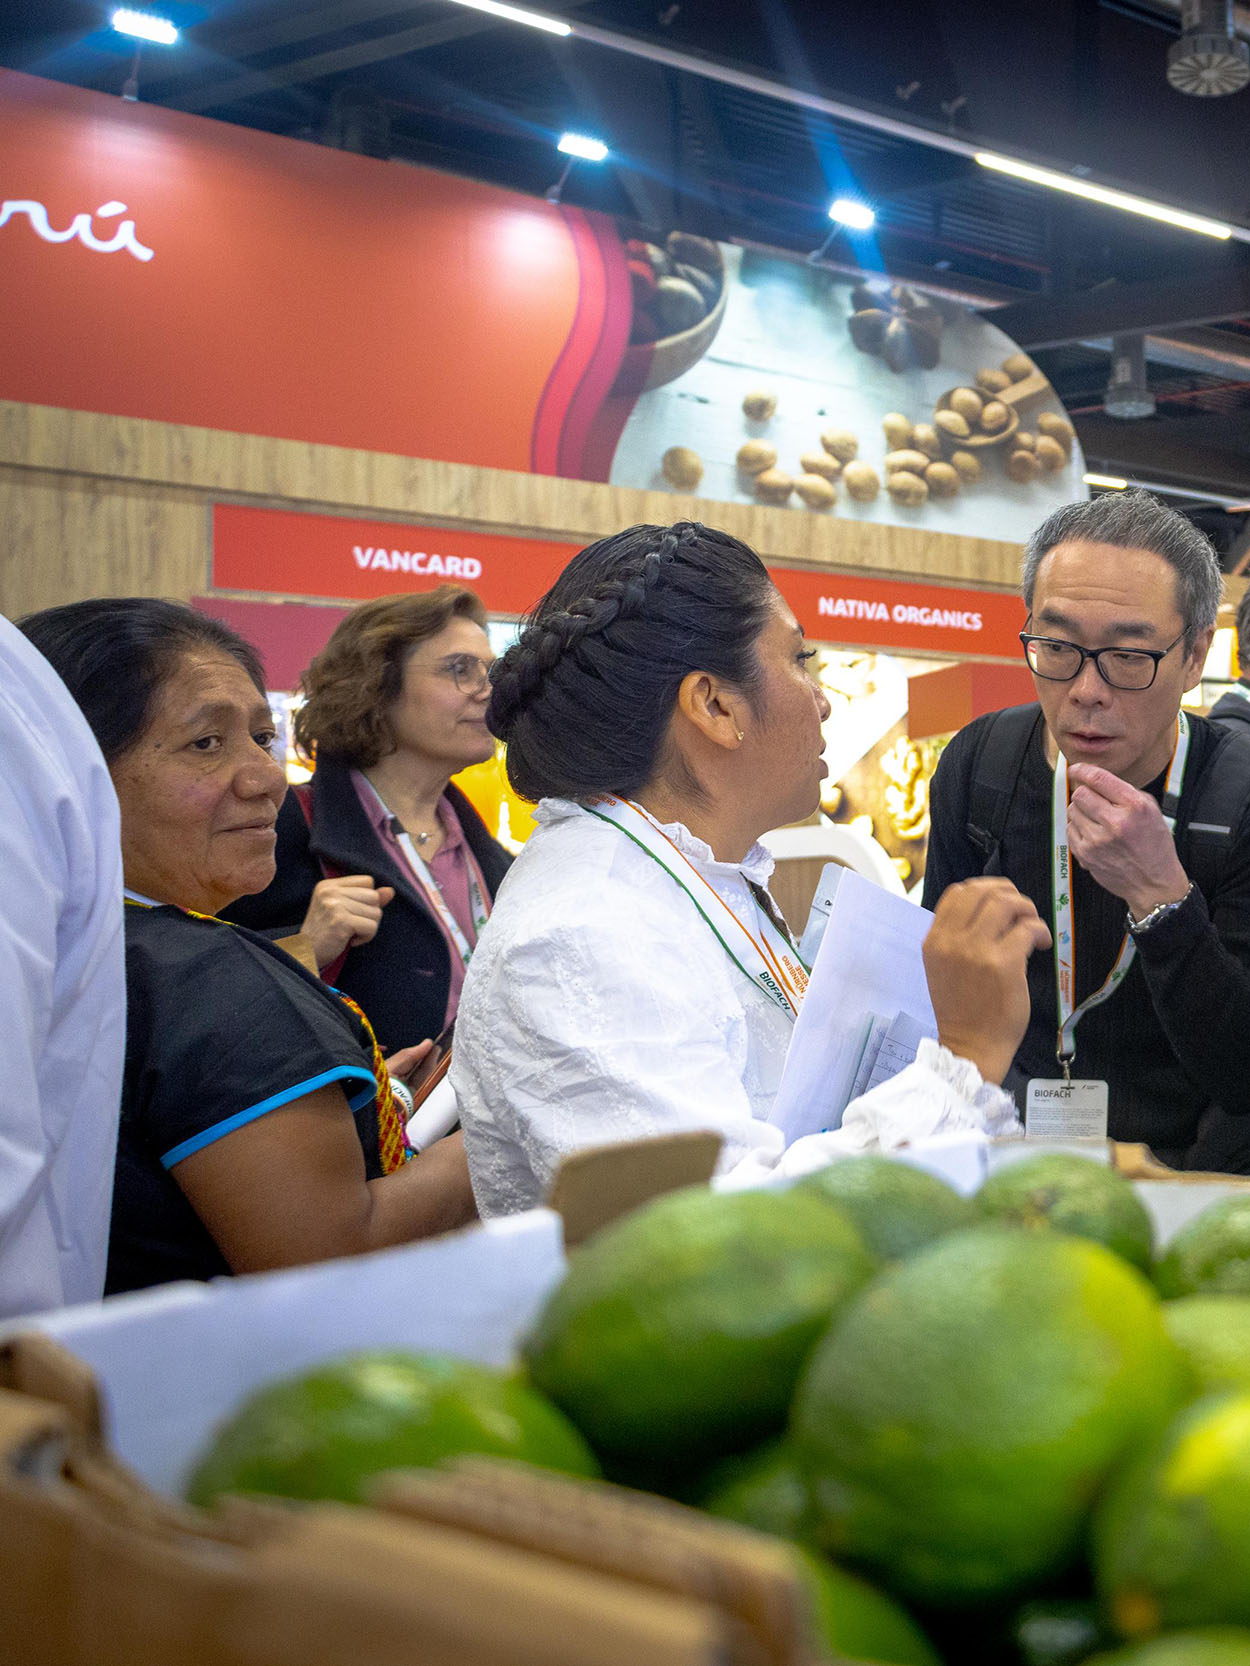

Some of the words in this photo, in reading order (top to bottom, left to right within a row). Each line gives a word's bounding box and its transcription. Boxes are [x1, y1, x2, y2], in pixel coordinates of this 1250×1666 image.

[0, 200, 154, 262] rú
[353, 546, 482, 579] VANCARD
[818, 596, 889, 622] NATIVA
[892, 604, 983, 631] ORGANICS
[1060, 845, 1068, 879] BIOFACH
[759, 971, 790, 1010] BIOFACH
[1034, 1089, 1071, 1098] BIOFACH
